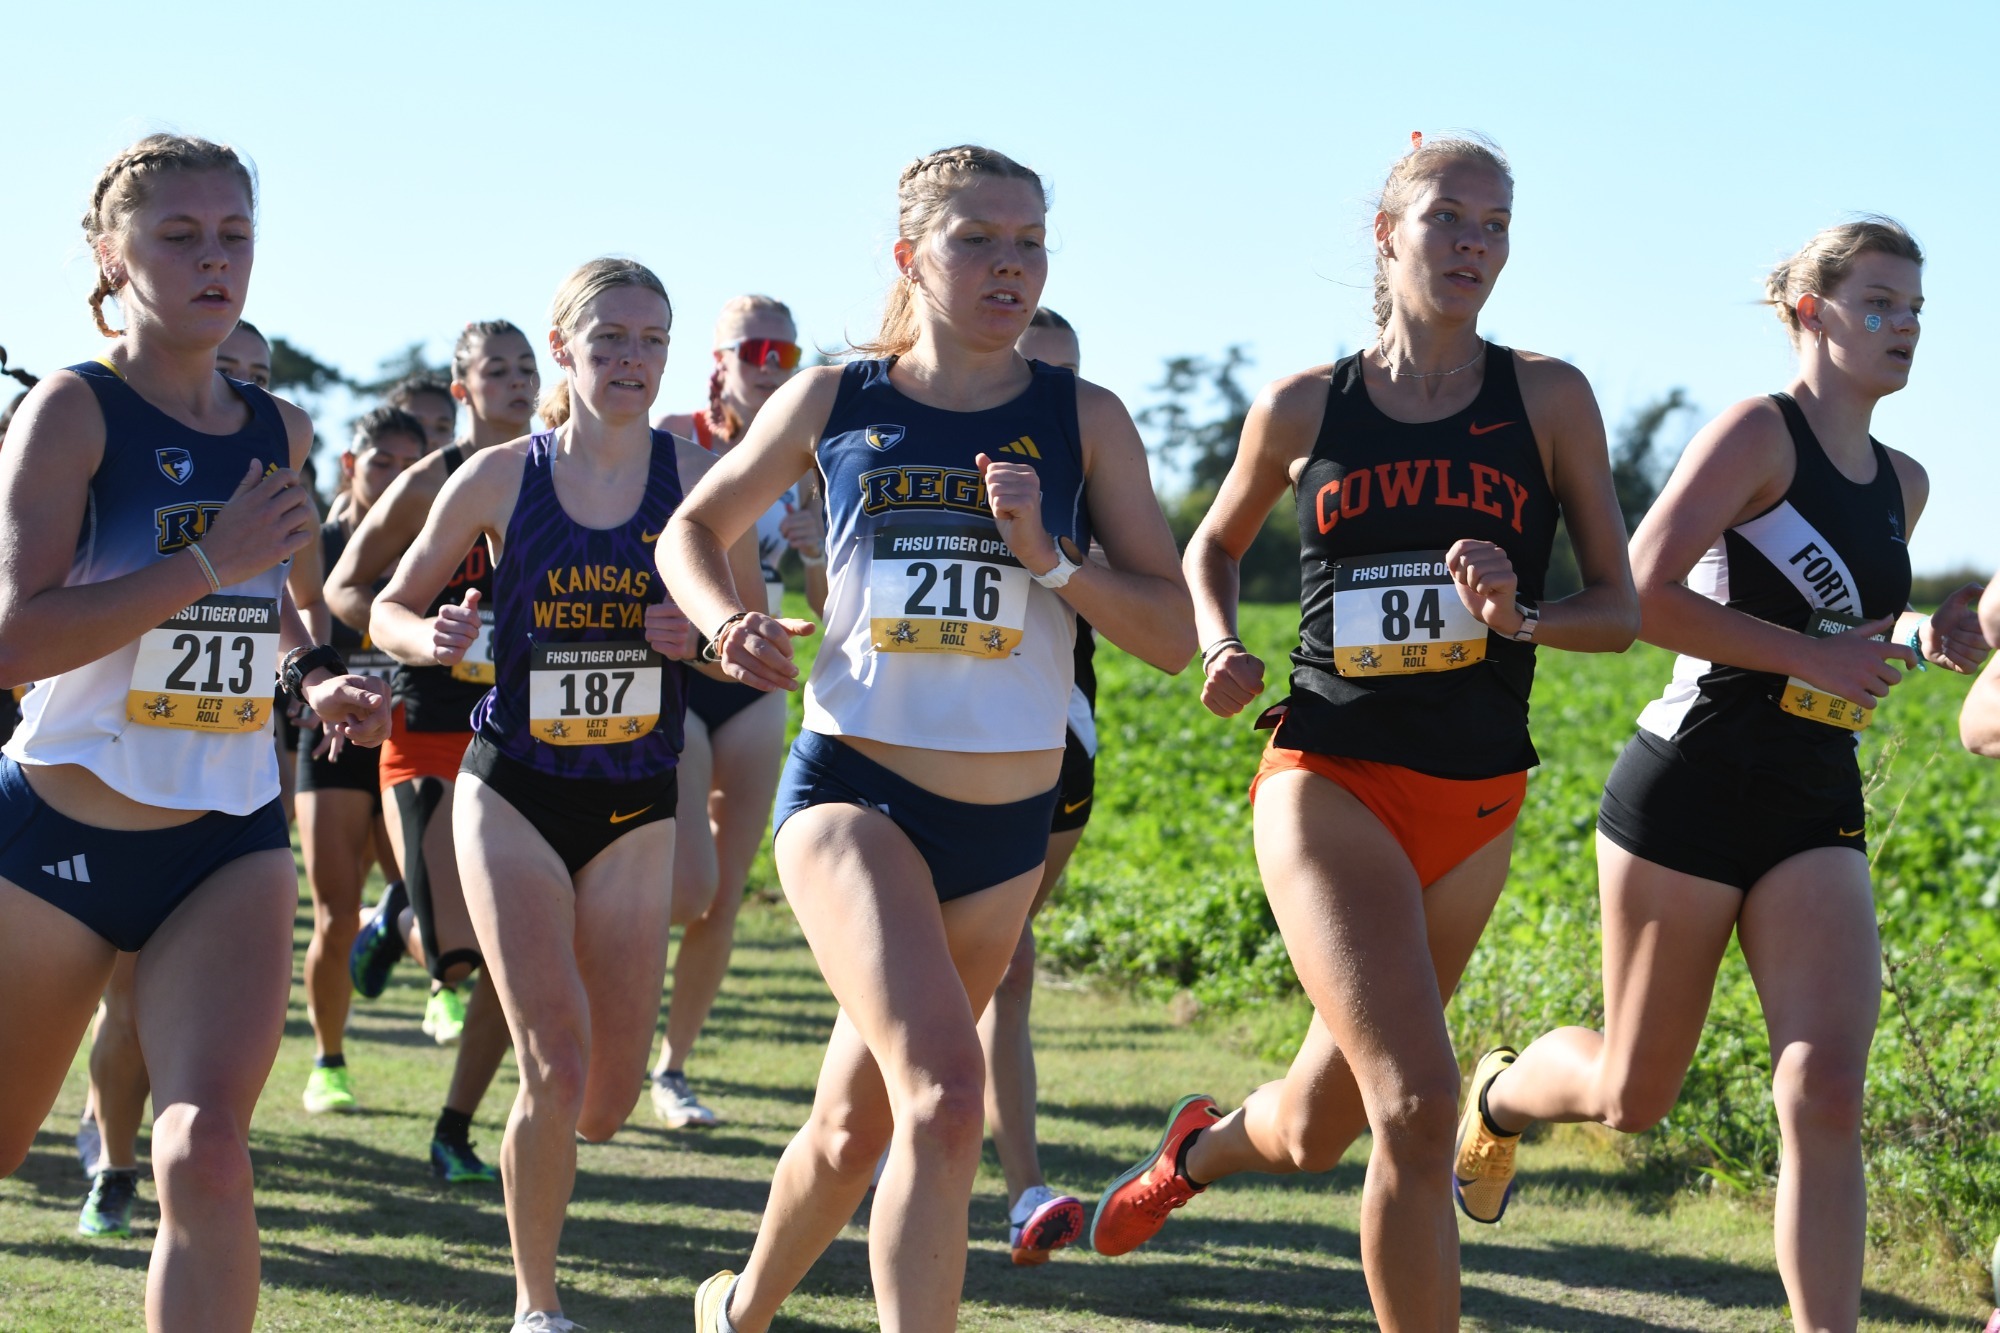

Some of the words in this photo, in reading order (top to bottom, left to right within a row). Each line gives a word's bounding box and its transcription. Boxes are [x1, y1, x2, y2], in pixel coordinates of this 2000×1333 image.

[859, 465, 994, 519] REG
[1315, 459, 1529, 536] COWLEY
[892, 536, 934, 551] FHSU
[936, 536, 978, 553] TIGER
[1352, 565, 1389, 582] FHSU
[1391, 562, 1431, 578] TIGER
[1788, 541, 1850, 607] FORT
[547, 565, 650, 598] KANSAS
[904, 561, 1002, 622] 216
[201, 606, 237, 622] TIGER
[238, 607, 269, 624] OPEN
[533, 601, 646, 628] WESLEYA
[1380, 588, 1445, 642] 84
[940, 621, 968, 633] LET'S
[940, 633, 966, 647] ROLL
[546, 651, 579, 664] FHSU
[580, 650, 614, 663] TIGER
[616, 649, 648, 662] OPEN
[1401, 645, 1428, 656] LET'S
[165, 633, 254, 694] 213
[1402, 656, 1427, 668] ROLL
[560, 671, 635, 716] 187
[197, 697, 223, 711] LET'S
[195, 710, 220, 723] ROLL
[1827, 708, 1844, 720] ROLL
[586, 719, 608, 728] LET'S
[587, 729, 607, 738] ROLL
